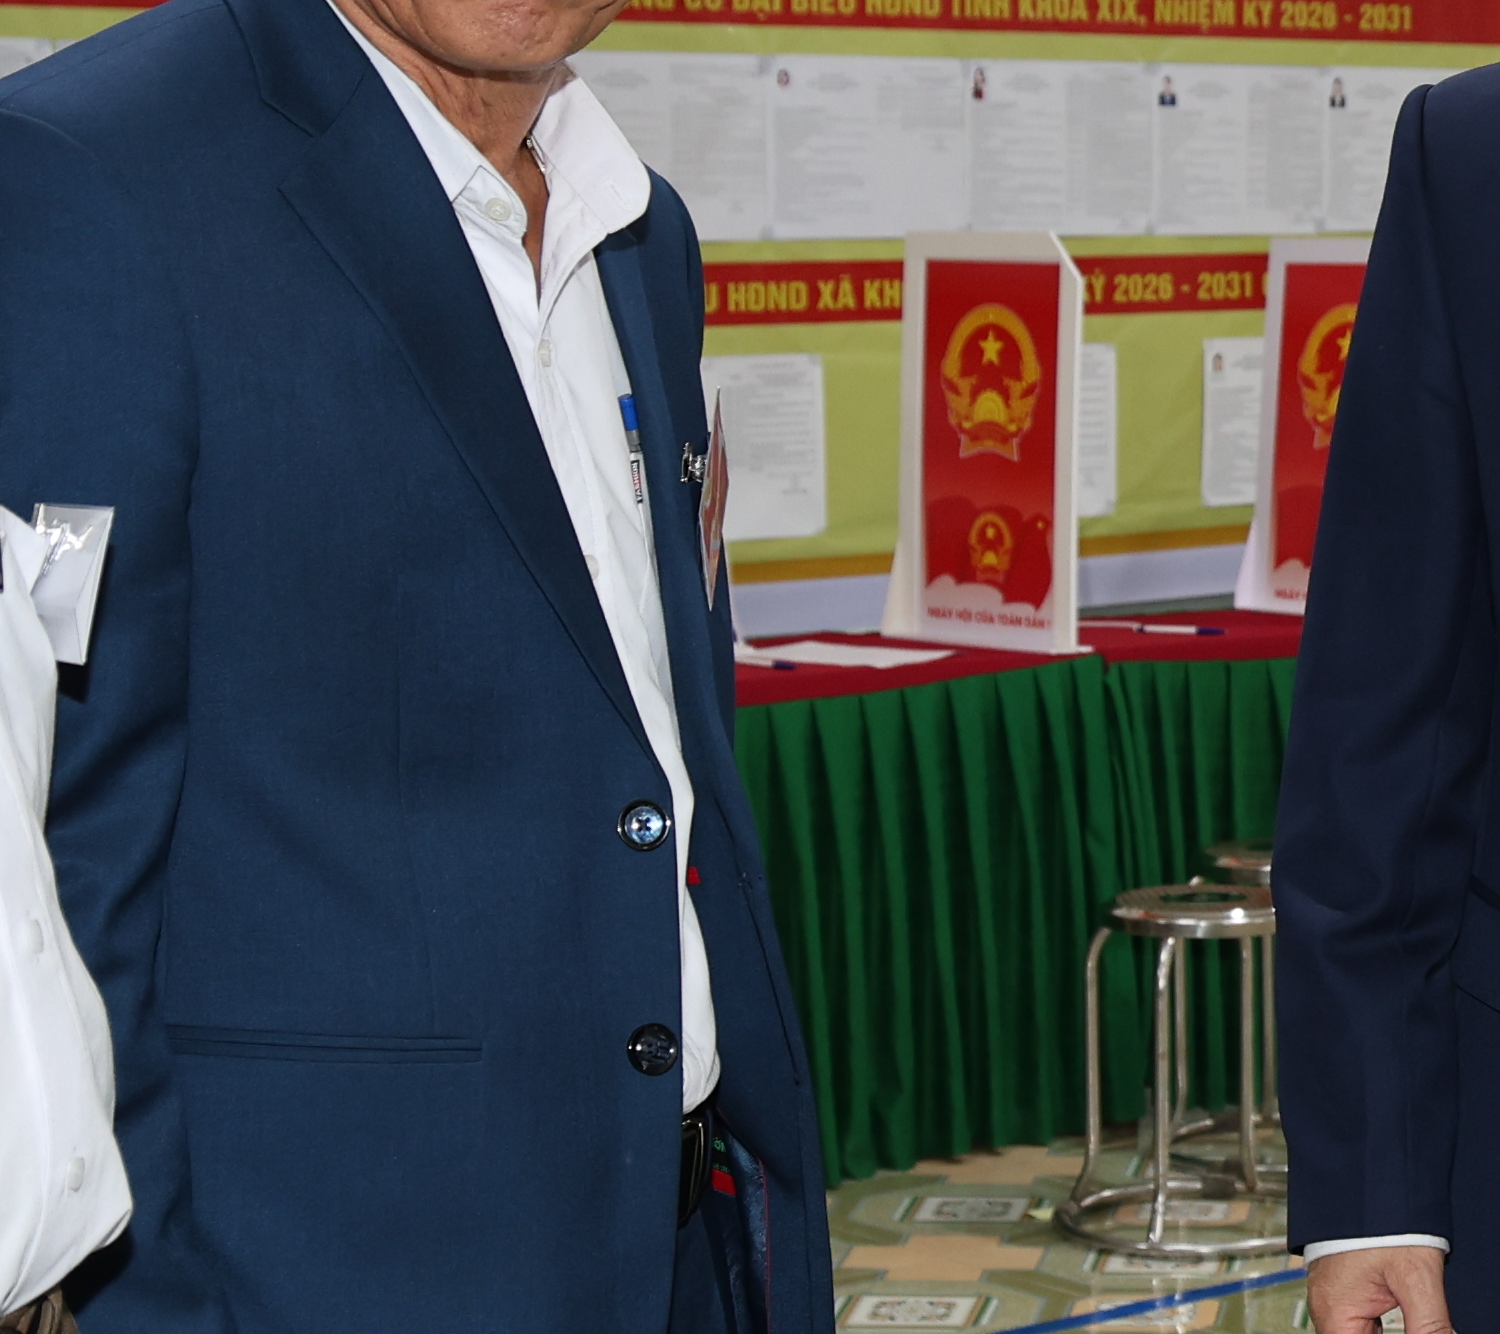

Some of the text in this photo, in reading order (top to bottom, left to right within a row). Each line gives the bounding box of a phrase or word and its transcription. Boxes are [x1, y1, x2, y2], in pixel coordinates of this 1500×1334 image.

[1281, 0, 1336, 31] 2026
[1358, 2, 1413, 33] 2031
[728, 279, 809, 313] HĐND
[817, 271, 856, 311] XÃ
[1113, 273, 1173, 302] 2026
[1197, 271, 1253, 299] 2031
